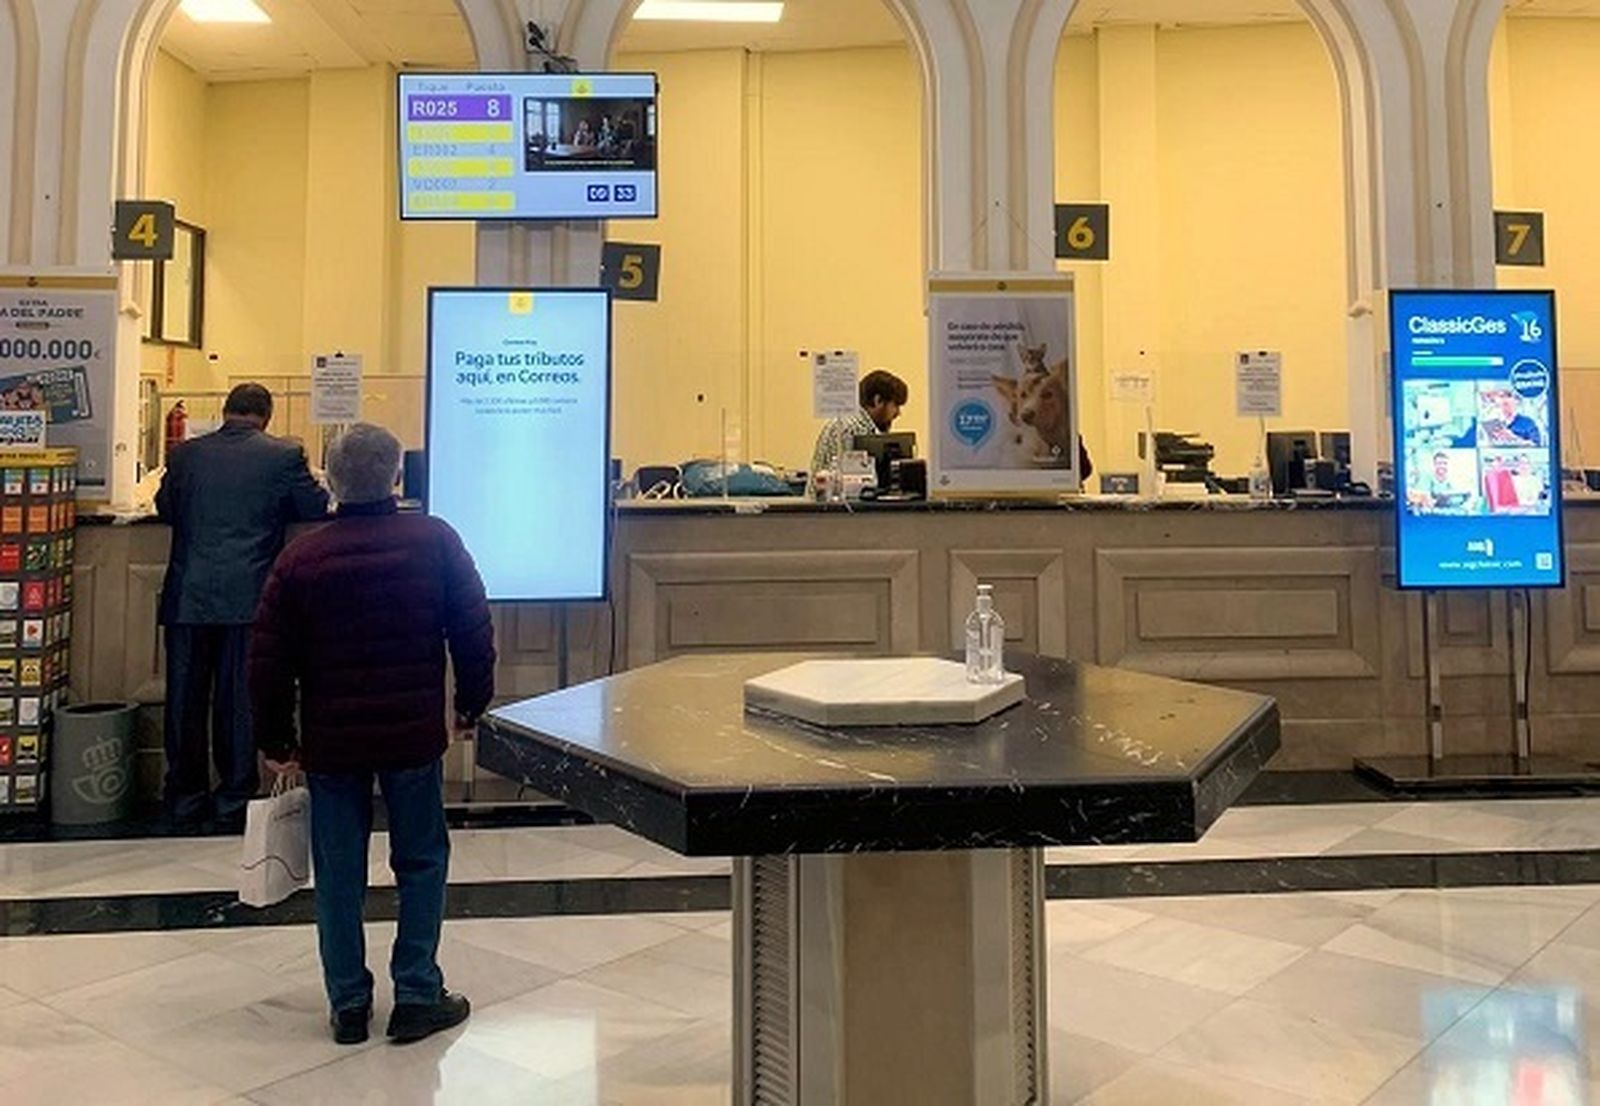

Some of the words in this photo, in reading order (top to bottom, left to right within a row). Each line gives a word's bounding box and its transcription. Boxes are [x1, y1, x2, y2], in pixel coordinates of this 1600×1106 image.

[412, 100, 458, 117] R025
[487, 98, 500, 117] 8
[128, 213, 158, 248] 4
[1068, 216, 1095, 250] 6
[1507, 224, 1531, 256] 7
[619, 253, 643, 289] 5
[1520, 318, 1542, 341] 16
[455, 351, 495, 370] Paga
[498, 352, 522, 367] tus
[525, 350, 585, 367] tributos
[496, 373, 517, 385] en
